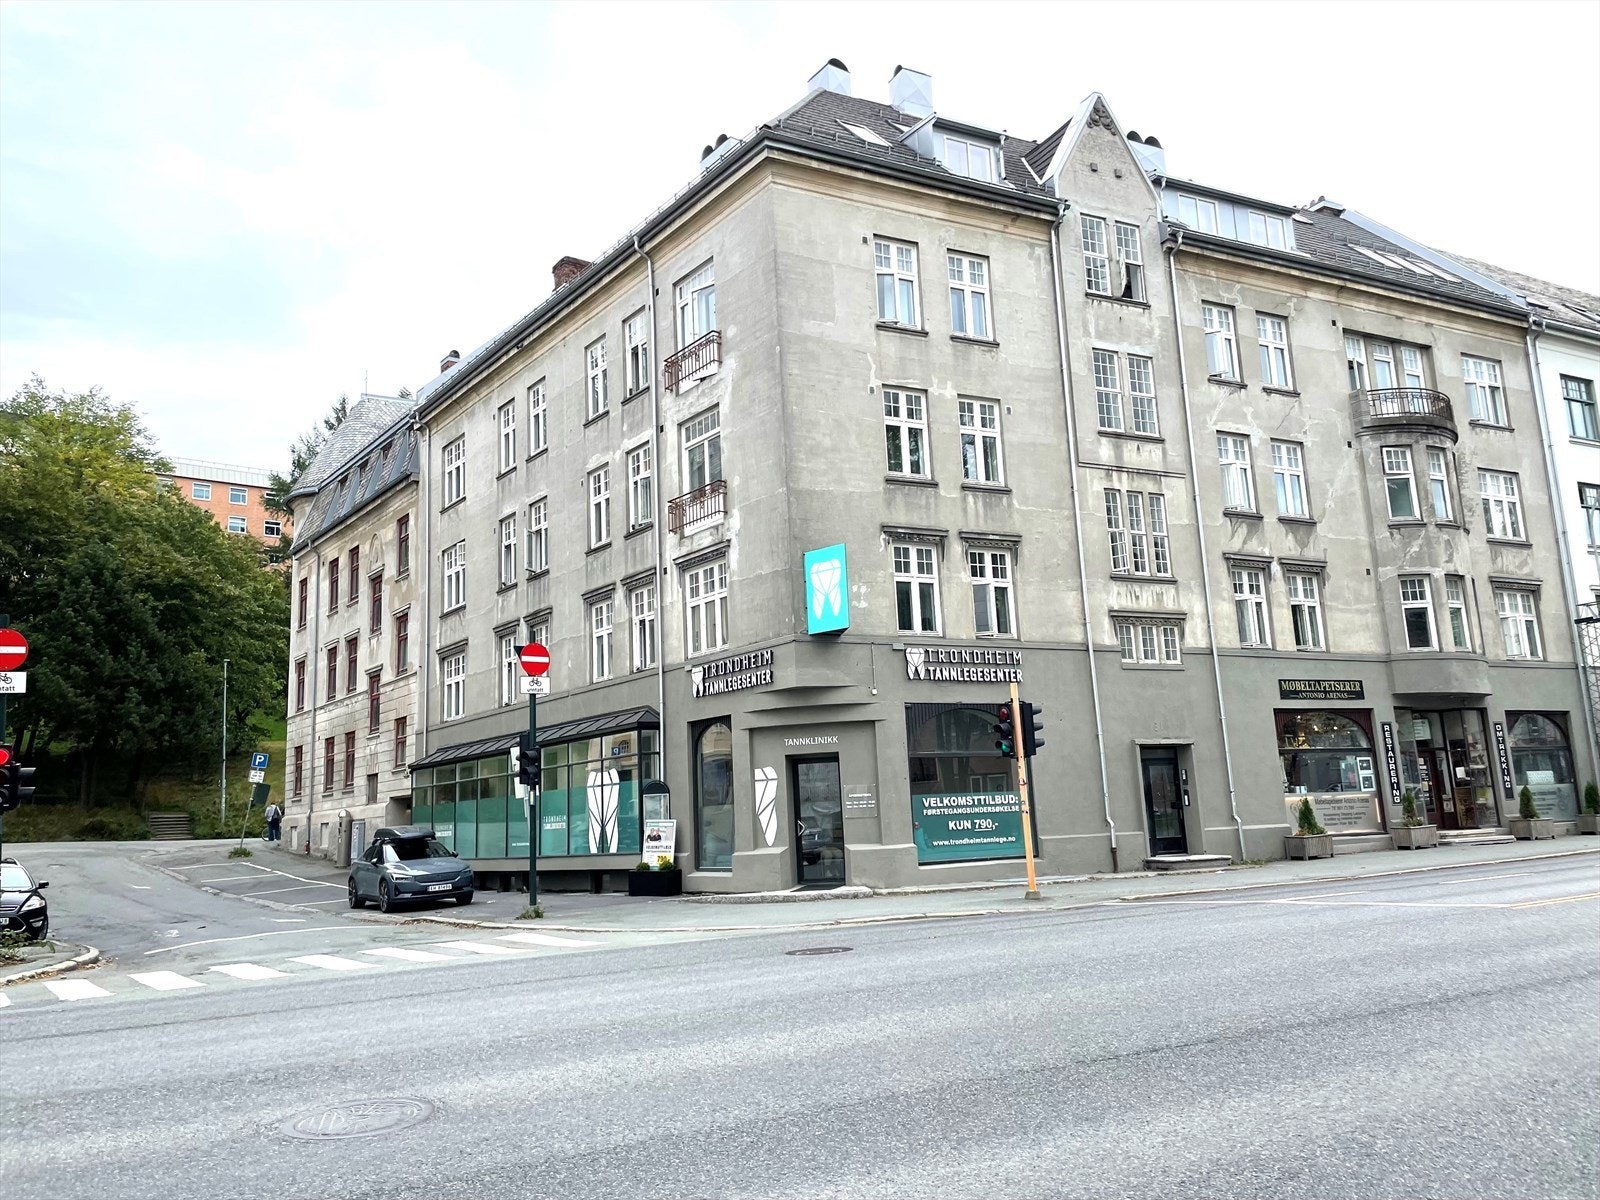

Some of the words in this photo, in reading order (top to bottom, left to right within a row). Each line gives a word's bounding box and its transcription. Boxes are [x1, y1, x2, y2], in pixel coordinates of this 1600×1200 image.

[704, 649, 773, 678] TRONDHEIM
[925, 648, 1022, 665] TRONDHEIM
[927, 666, 1024, 682] TANNLEGESENTER
[704, 669, 772, 696] TANNLEGESENTER
[1281, 681, 1361, 691] MØBELTAPETSERER
[784, 736, 839, 747] TANNKLINIKK
[255, 755, 265, 766] P
[1495, 724, 1511, 788] OMTREKKING
[1383, 724, 1400, 803] RESTAURERING
[922, 794, 1019, 808] VELKOMSTTILBUD:
[923, 805, 1020, 816] FØRSTEGANGSUNDERSØKELSE
[948, 820, 972, 831] KUN
[974, 819, 999, 832] 790,-
[932, 836, 1017, 847] www.trondheimtannlege.no
